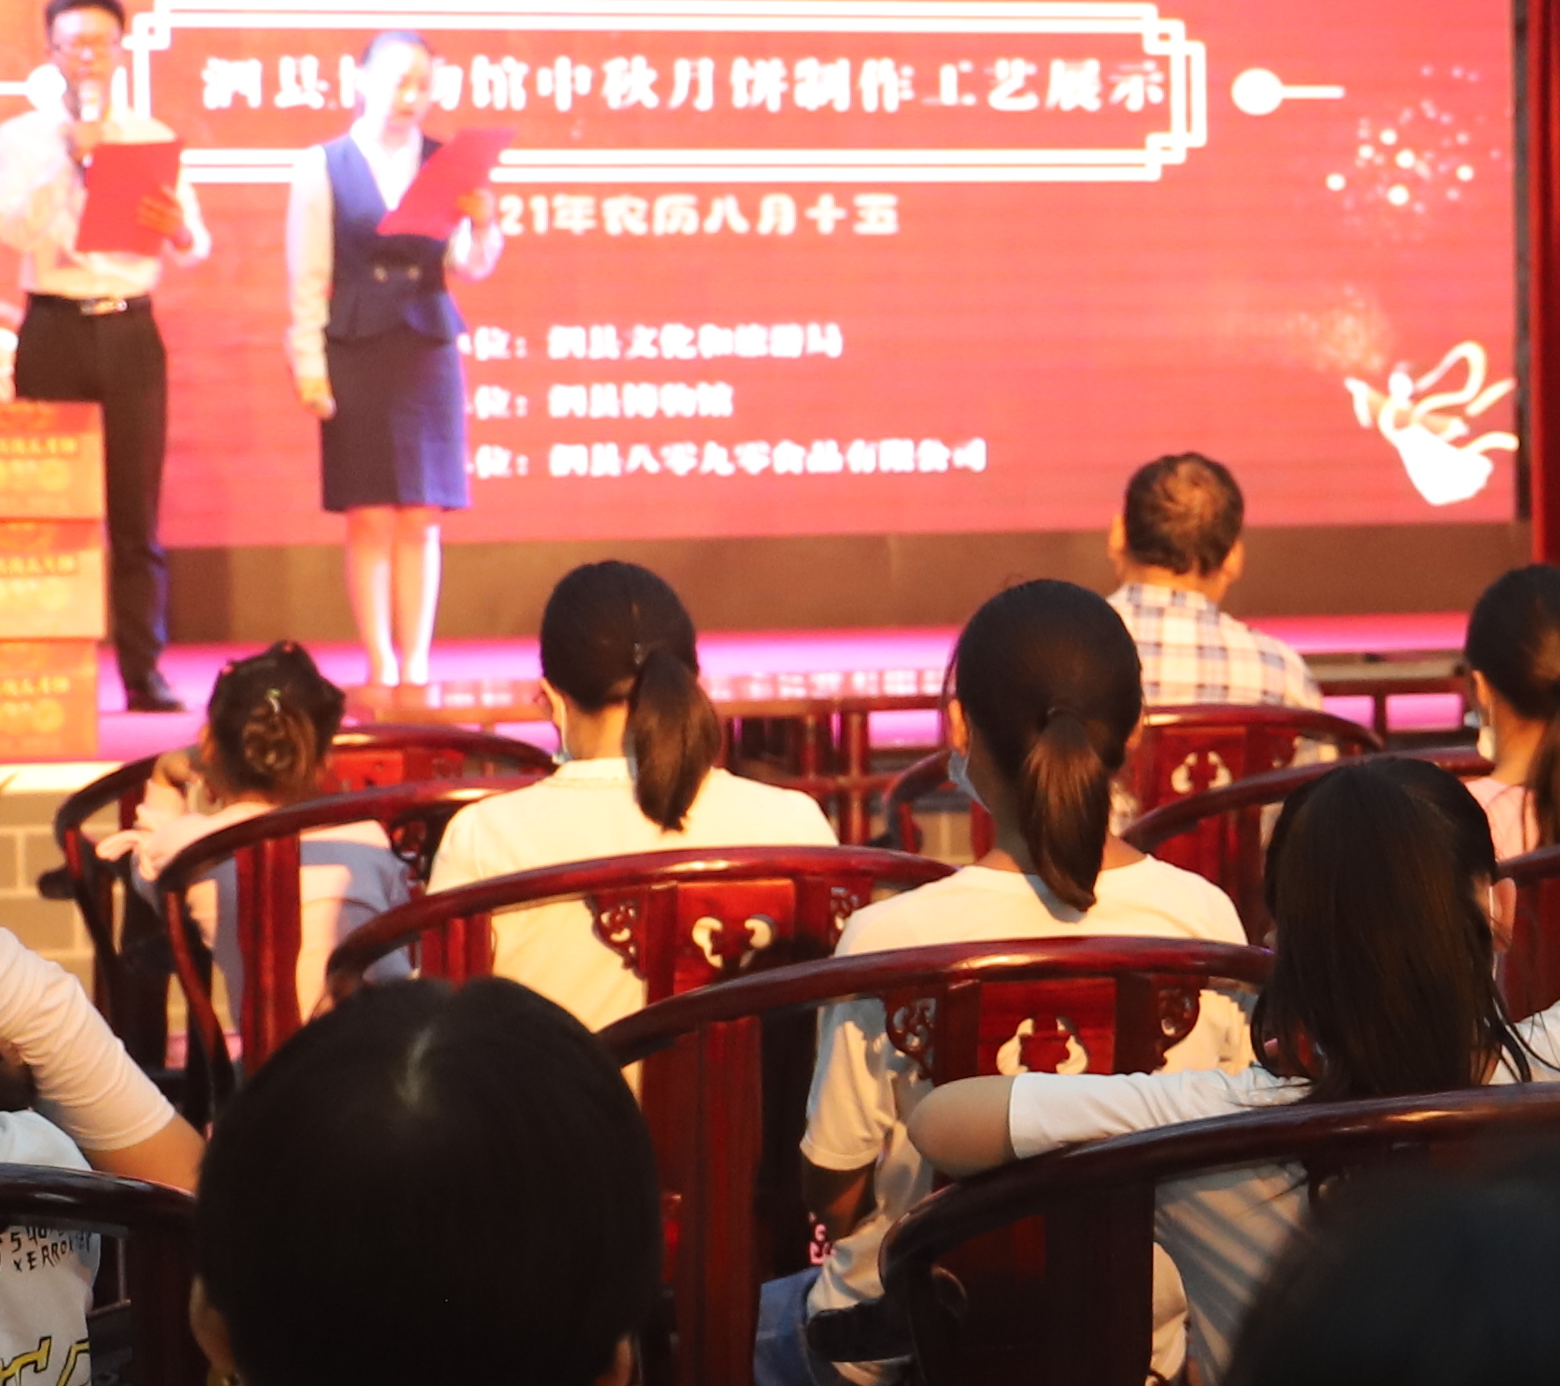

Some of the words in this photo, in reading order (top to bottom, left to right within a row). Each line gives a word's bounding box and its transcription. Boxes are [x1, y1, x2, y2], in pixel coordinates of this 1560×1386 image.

[466, 437, 987, 479] 位：泗县八零九零食品有限公司
